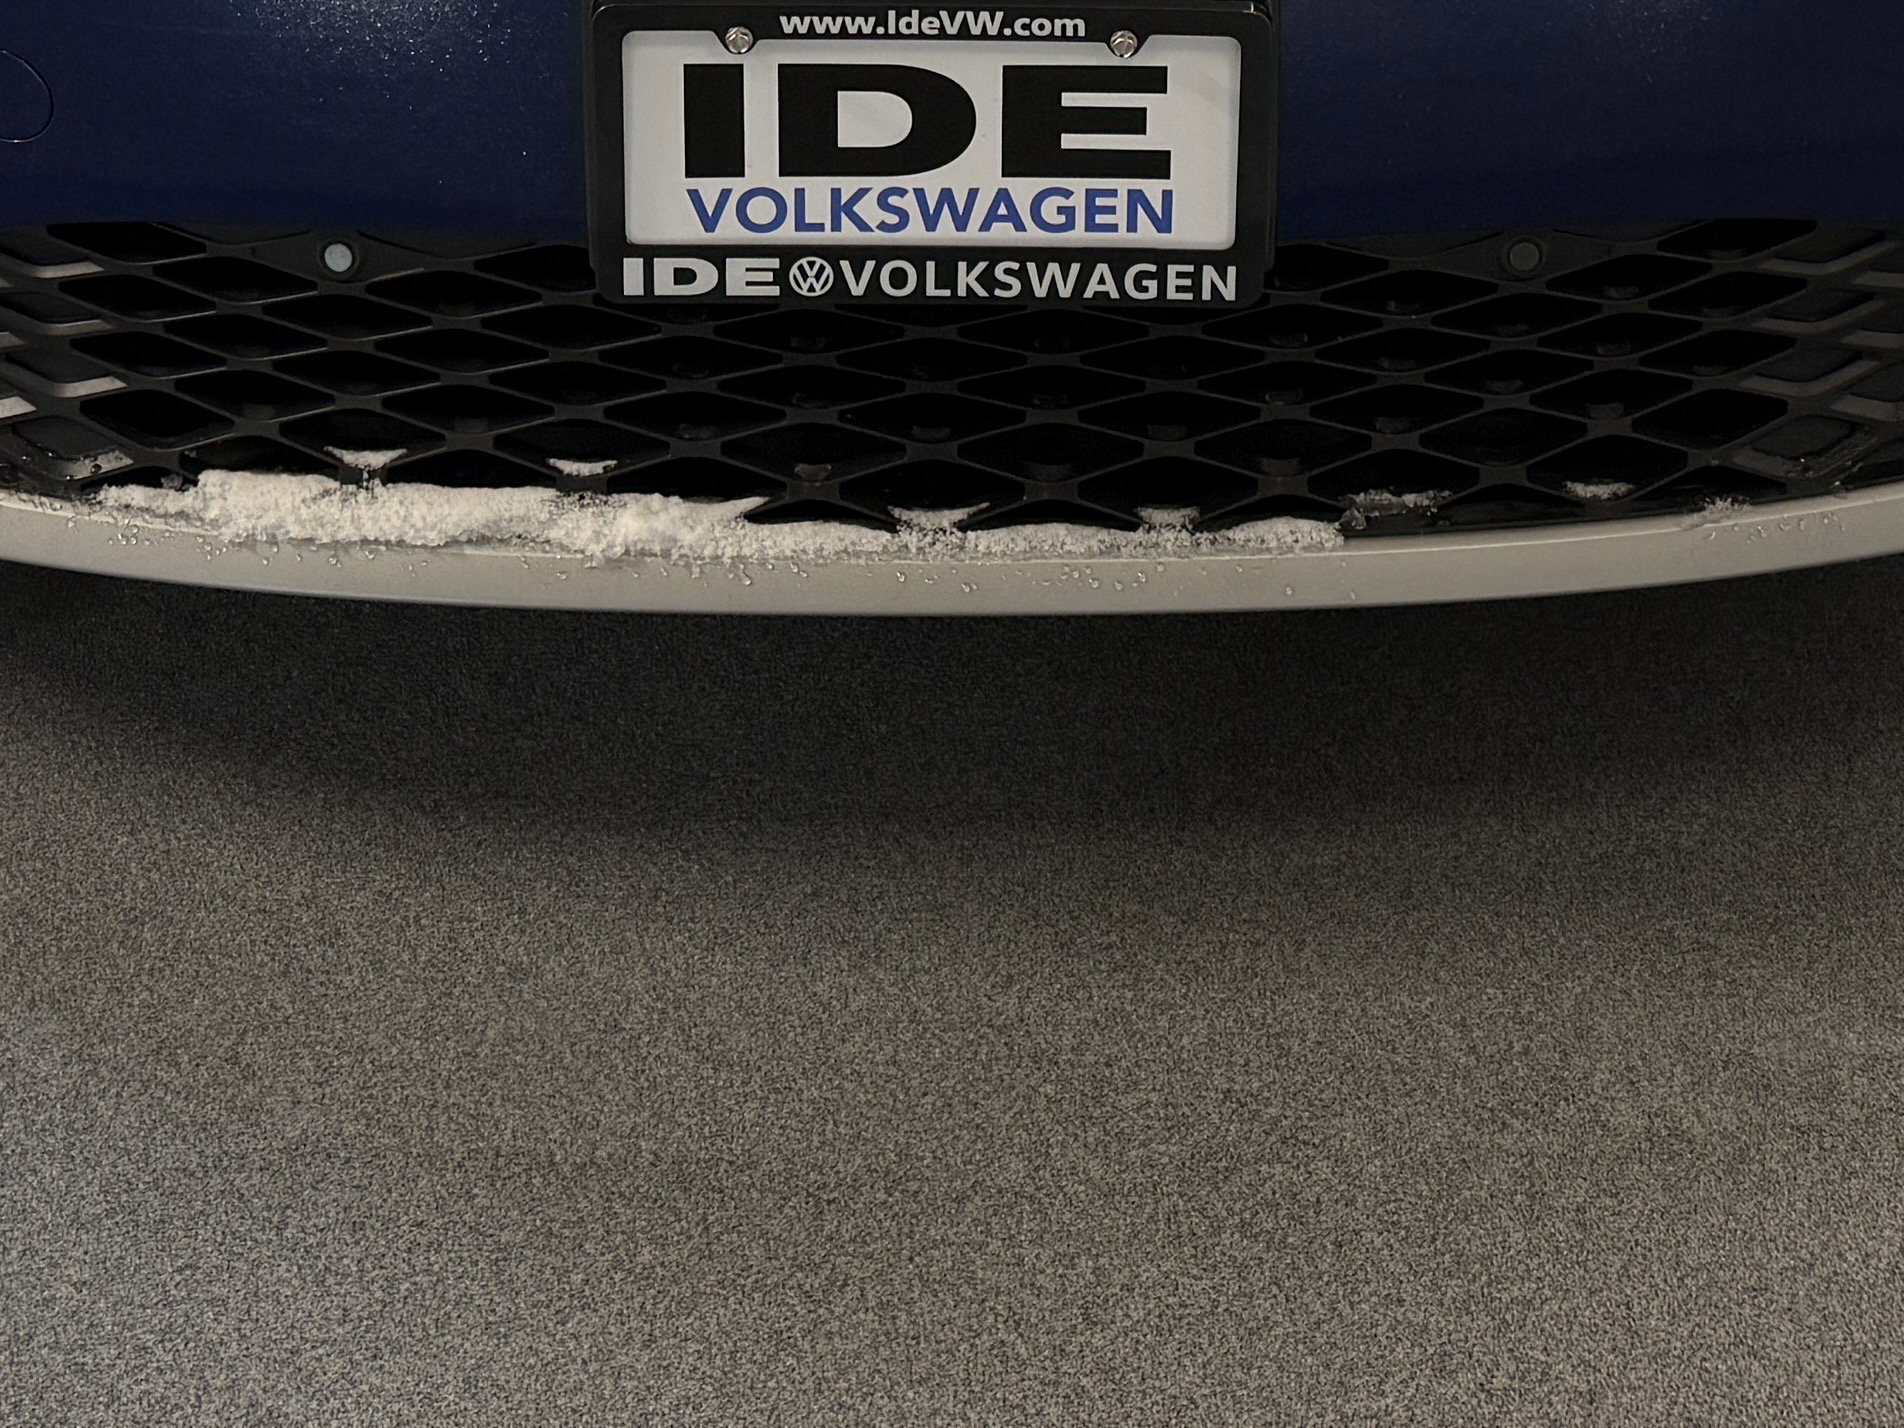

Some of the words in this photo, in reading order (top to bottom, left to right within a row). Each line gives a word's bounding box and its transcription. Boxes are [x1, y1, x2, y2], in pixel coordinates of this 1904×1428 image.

[780, 10, 1086, 38] www.IdeVW.com
[684, 63, 1172, 179] IDE
[686, 187, 1173, 234] VOLKSWAGEN
[623, 257, 780, 296] IDE
[840, 260, 1237, 302] VOLKSWAGEN
